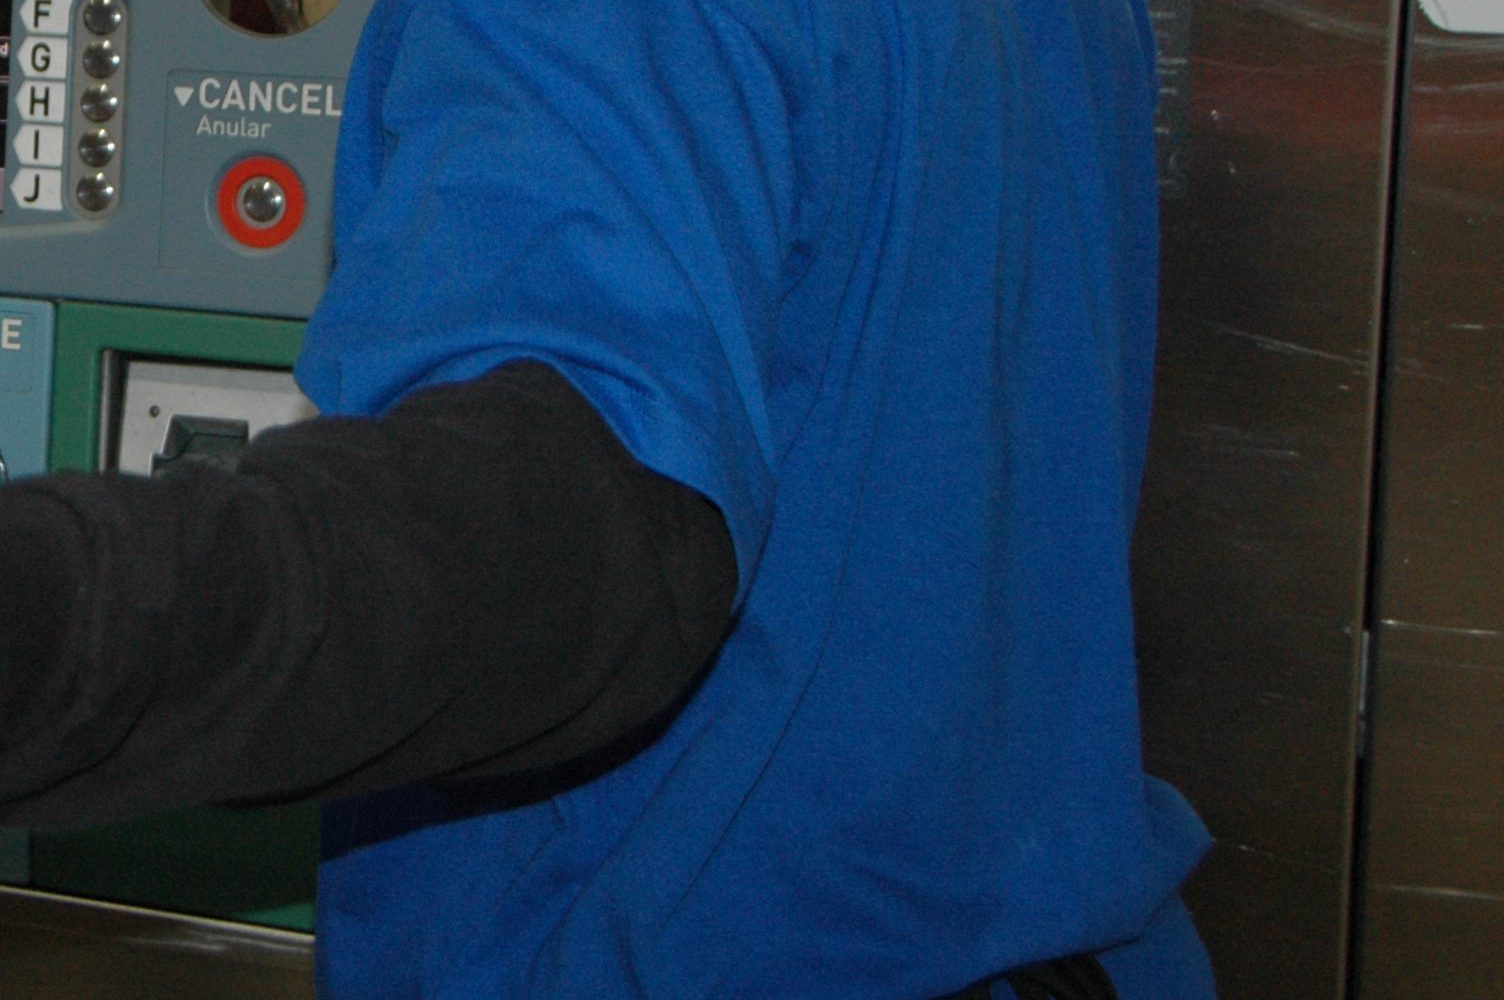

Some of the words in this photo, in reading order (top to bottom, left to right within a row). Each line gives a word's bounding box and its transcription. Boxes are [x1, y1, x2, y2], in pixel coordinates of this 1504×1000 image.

[33, 0, 52, 28] F
[30, 42, 51, 72] G
[29, 86, 50, 117] H
[198, 77, 342, 117] CANCEL
[196, 114, 272, 138] Anular
[32, 130, 40, 160] I
[22, 173, 41, 204] J
